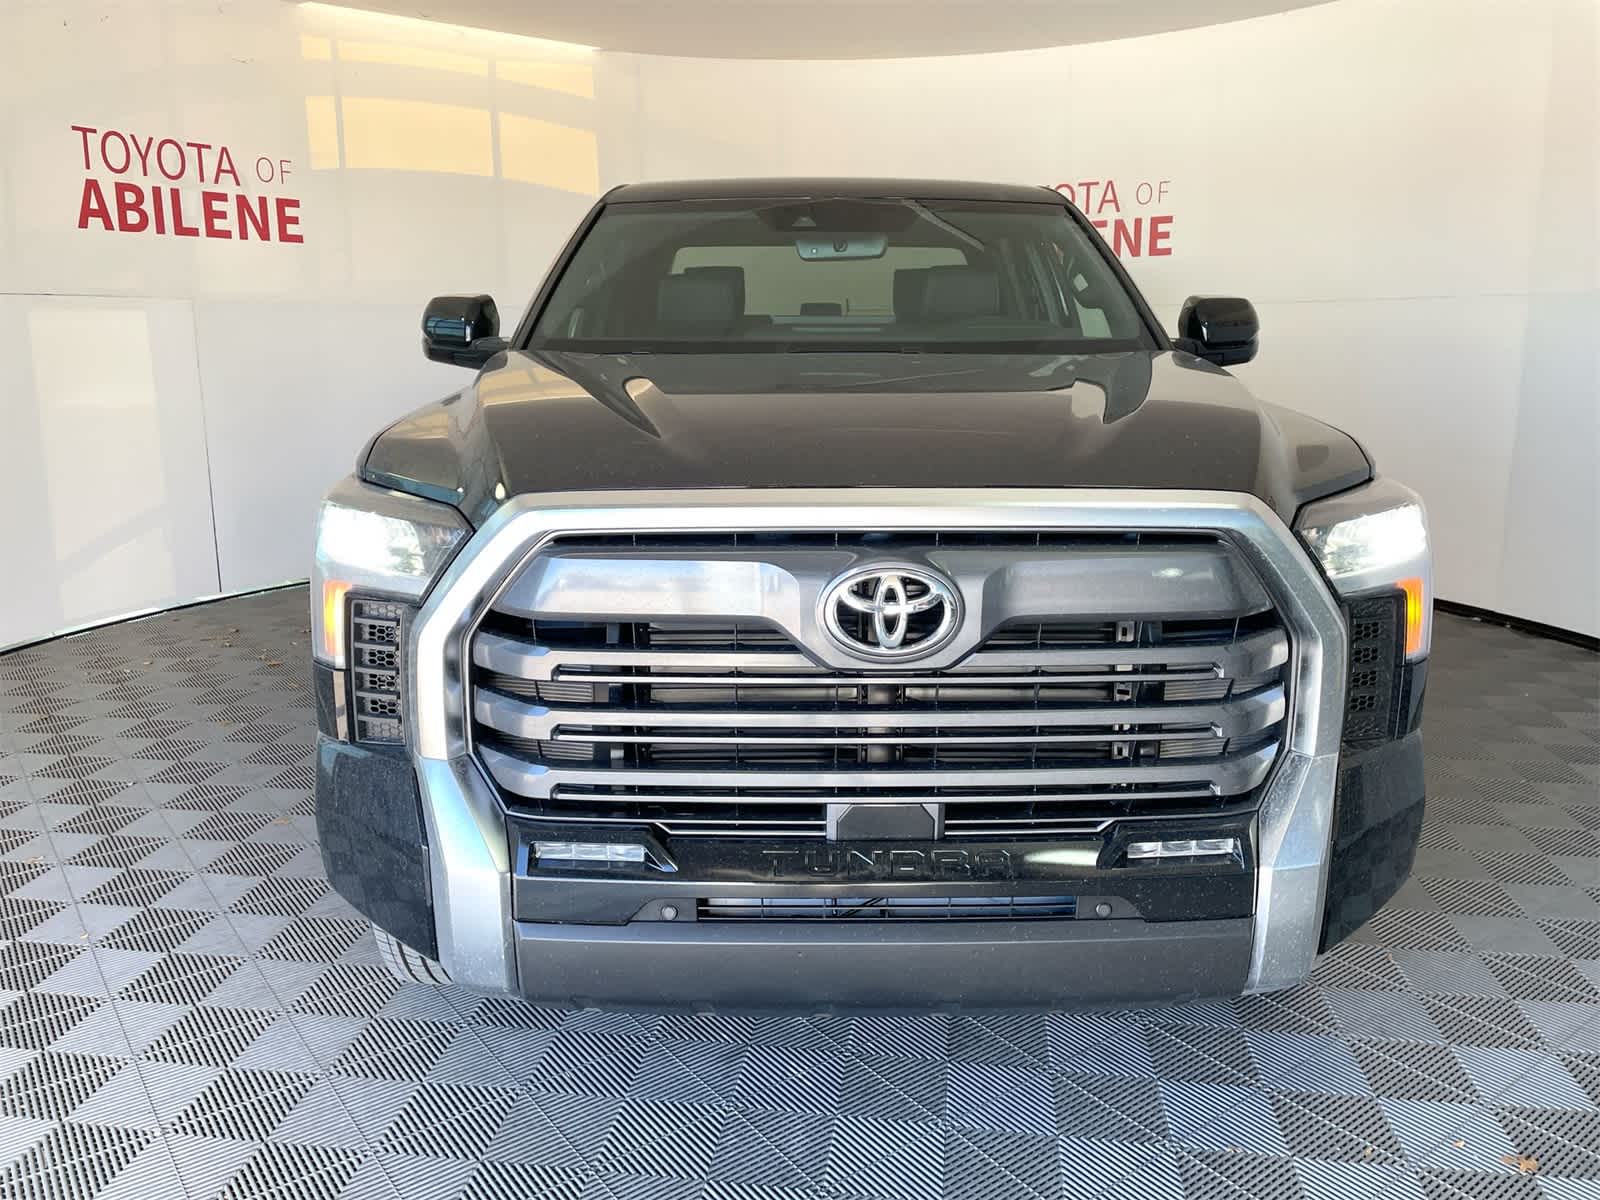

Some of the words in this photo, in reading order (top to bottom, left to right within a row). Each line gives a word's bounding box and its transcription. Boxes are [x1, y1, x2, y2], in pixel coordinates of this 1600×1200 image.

[71, 125, 241, 186] TOYOTA
[255, 156, 292, 184] OF
[78, 178, 304, 243] ABILENE
[1136, 180, 1170, 205] OF
[761, 850, 1014, 880] TUNDRA
